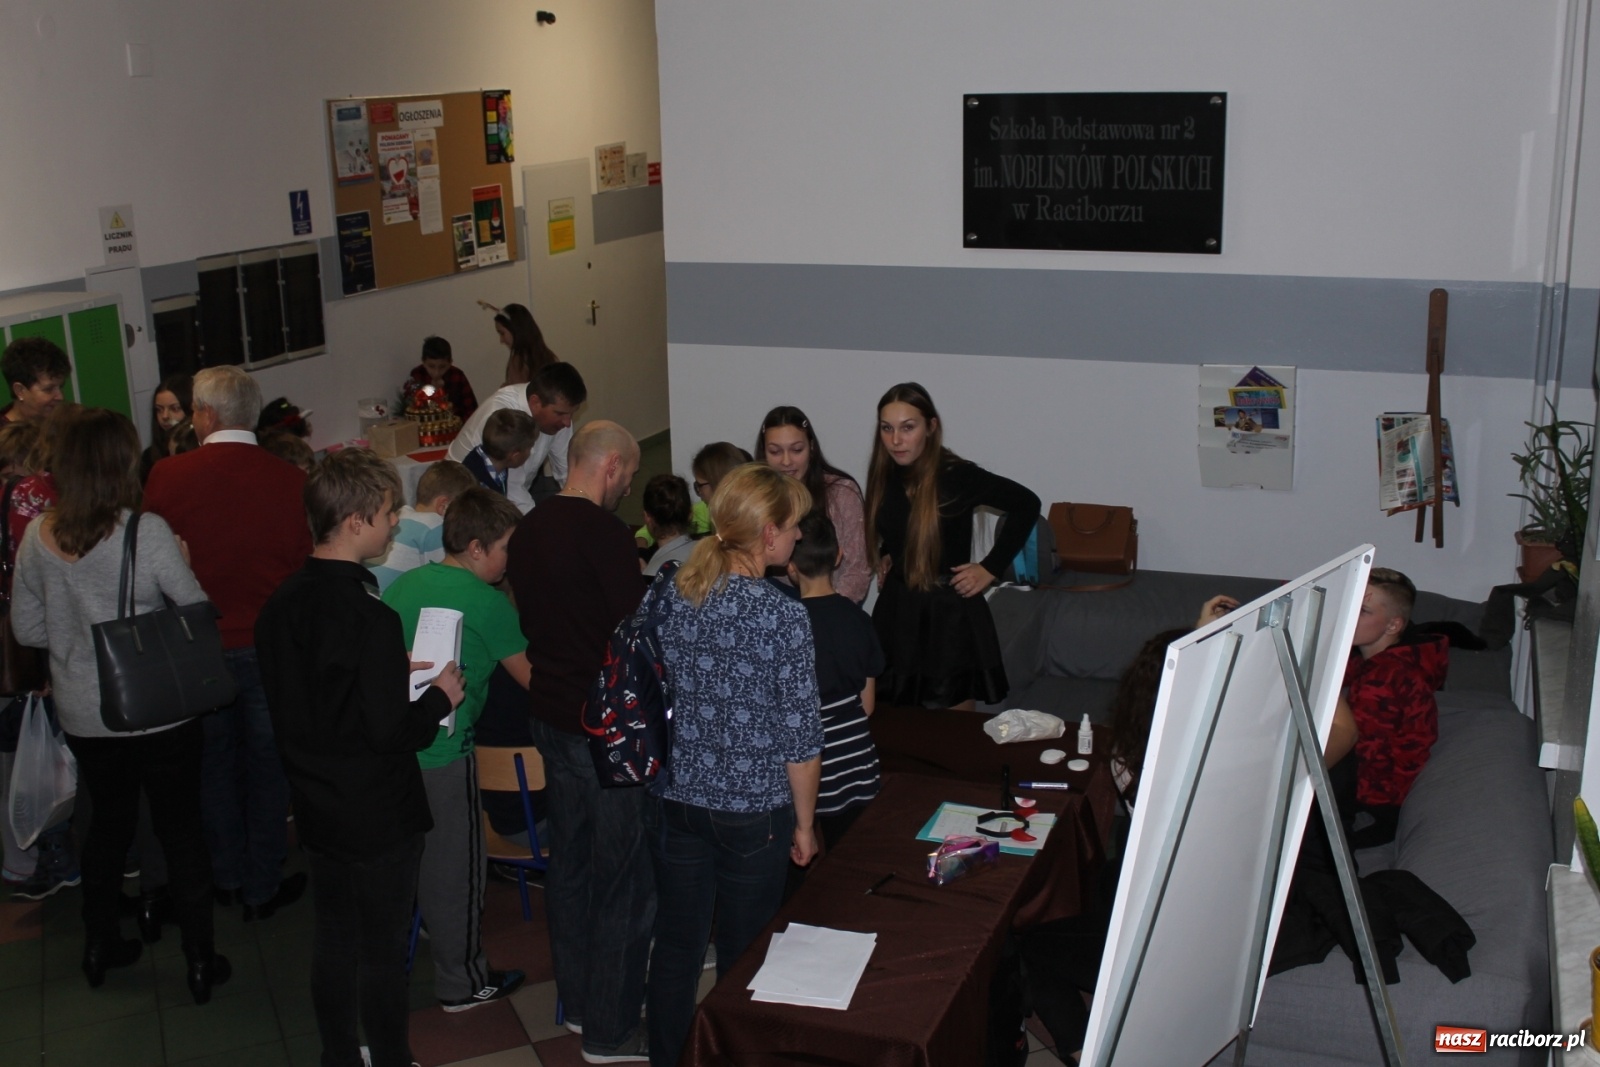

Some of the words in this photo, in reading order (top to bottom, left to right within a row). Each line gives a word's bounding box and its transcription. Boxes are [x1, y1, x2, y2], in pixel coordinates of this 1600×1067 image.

[399, 108, 442, 122] OGŁOSZENIA
[989, 116, 1046, 141] Szkoła
[1051, 116, 1155, 141] Podstawowa
[1160, 122, 1180, 140] nr
[1183, 116, 1196, 140] 2
[973, 157, 998, 188] im.
[999, 143, 1107, 190] NOBLISTÓW
[1111, 154, 1213, 191] POLSKICH
[1012, 202, 1030, 220] w
[1035, 194, 1144, 223] Raciborzu
[104, 231, 133, 241] LICZNIK
[108, 244, 133, 254] PRĄDU
